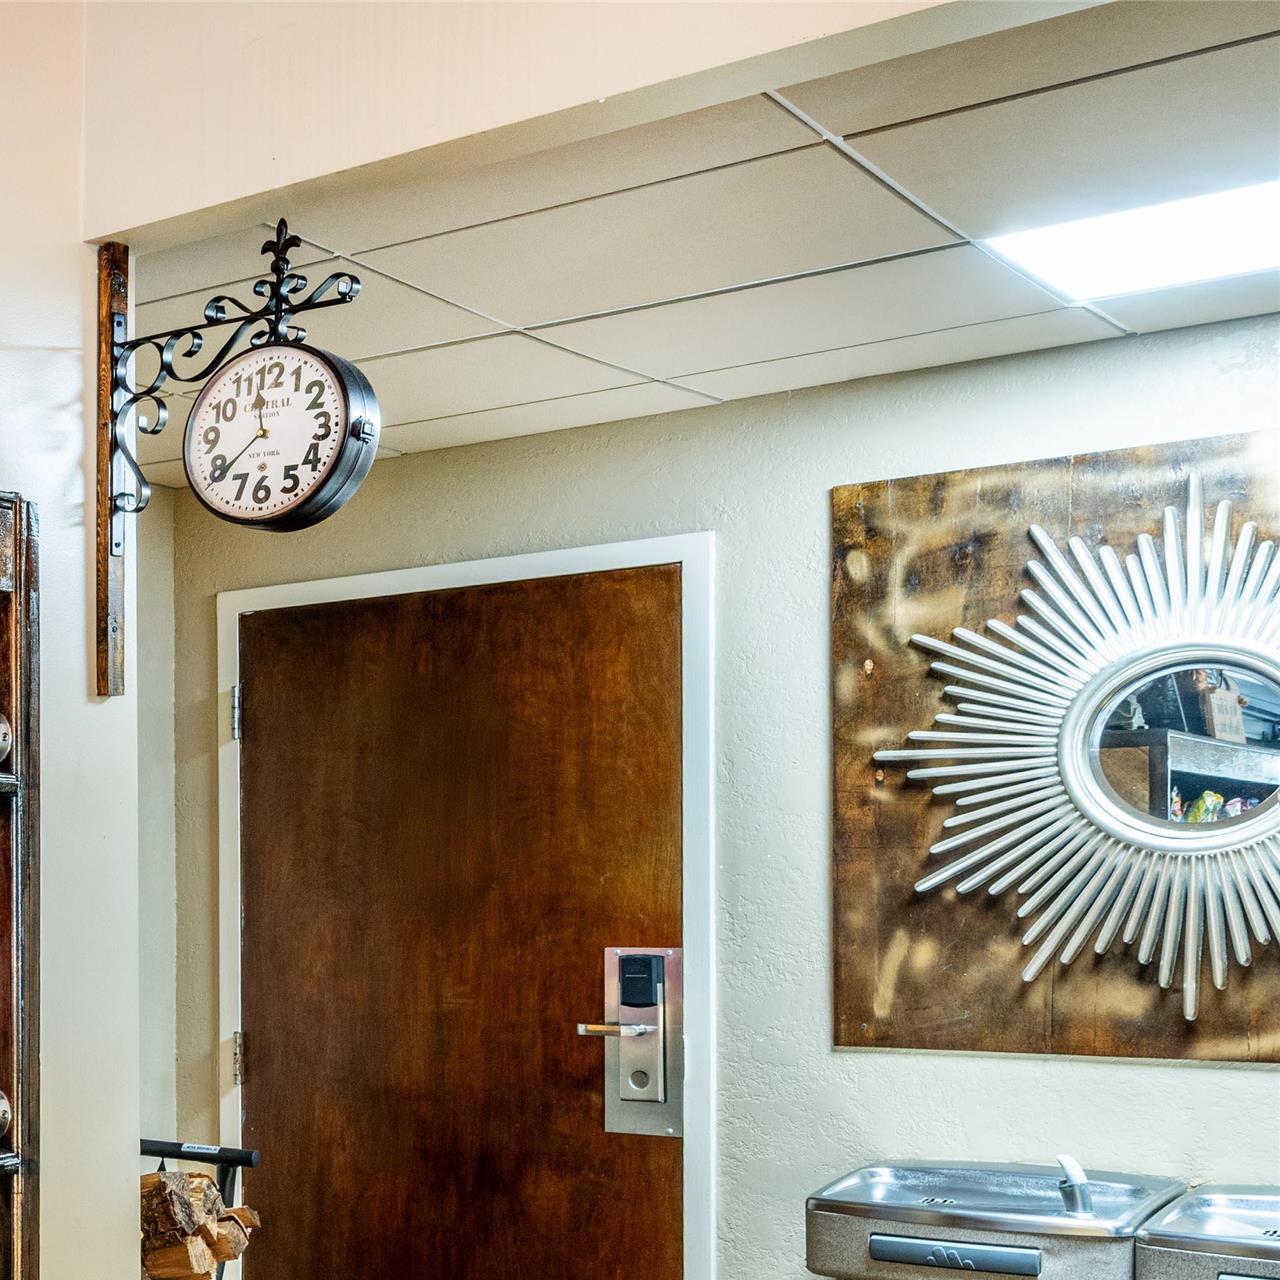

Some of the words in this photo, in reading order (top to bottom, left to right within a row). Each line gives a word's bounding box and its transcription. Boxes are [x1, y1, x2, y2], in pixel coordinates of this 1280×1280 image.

[232, 372, 254, 398] 11
[255, 361, 285, 389] 12
[290, 364, 303, 392] 1
[244, 397, 292, 413] CTRAL
[305, 380, 326, 411] 2
[212, 398, 237, 424] 10
[253, 410, 280, 419] SATION
[203, 426, 220, 454] 9
[312, 411, 331, 441] 3
[209, 454, 227, 482] 8
[263, 450, 280, 458] YORK
[301, 443, 321, 471] 4
[232, 473, 249, 501] 7
[252, 476, 271, 504] 6
[280, 464, 299, 494] 5
